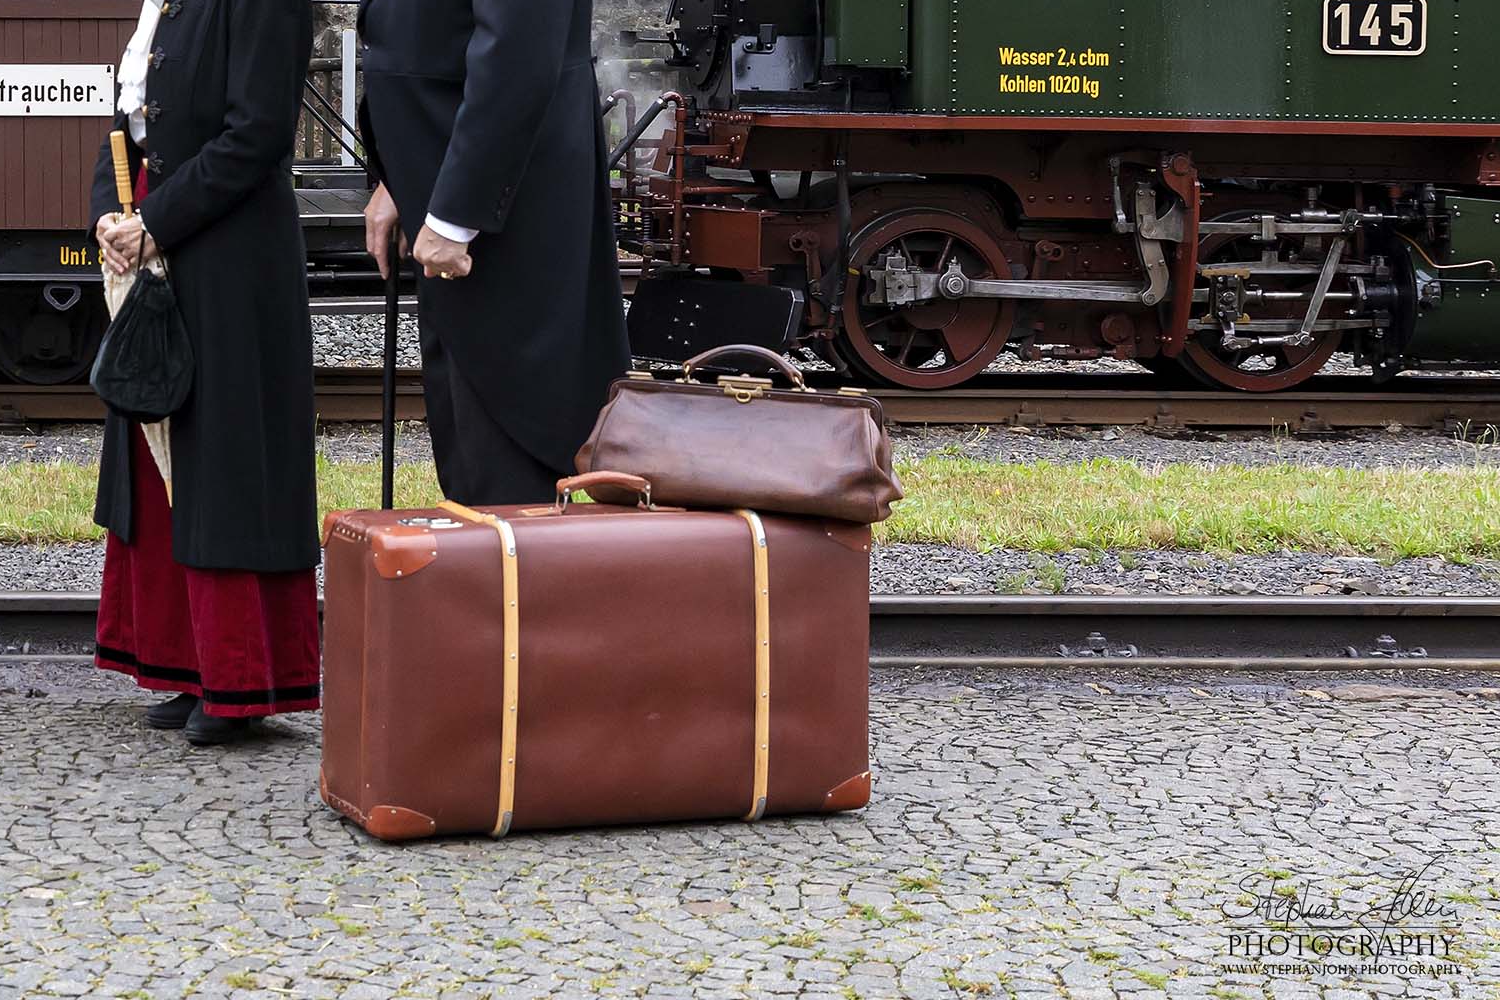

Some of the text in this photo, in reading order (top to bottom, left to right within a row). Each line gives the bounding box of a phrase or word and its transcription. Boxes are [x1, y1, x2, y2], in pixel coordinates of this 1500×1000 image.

[1334, 3, 1413, 46] 145
[999, 47, 1110, 67] Wasser 2,4 cbm
[1000, 74, 1100, 98] Kohlen 1020 kg
[60, 246, 92, 265] Unt.
